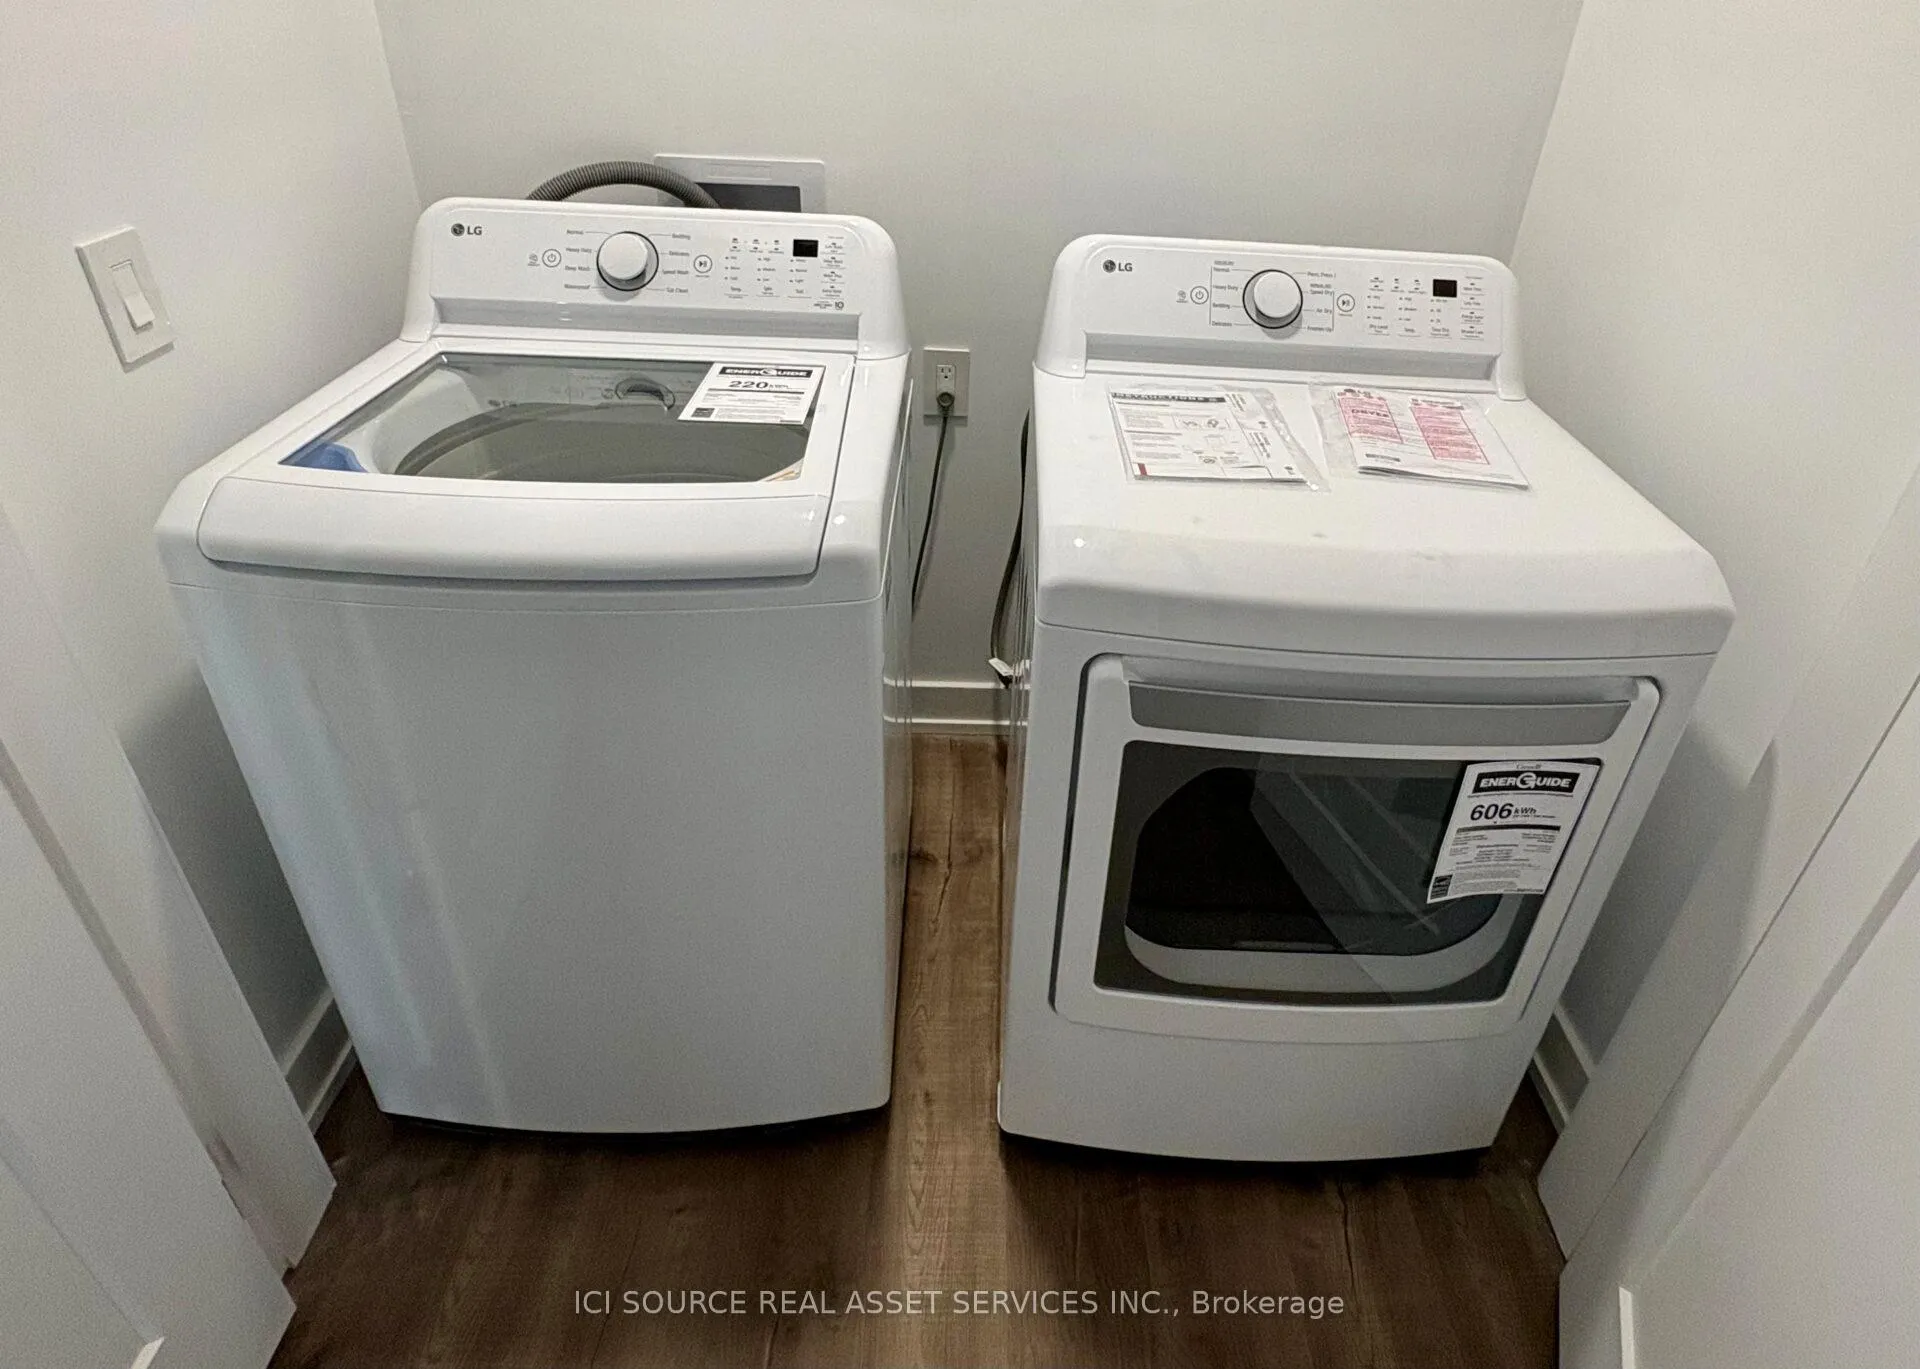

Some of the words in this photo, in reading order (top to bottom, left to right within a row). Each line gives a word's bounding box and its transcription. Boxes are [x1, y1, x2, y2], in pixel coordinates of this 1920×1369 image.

[725, 367, 808, 377] ENERGUIDE
[728, 380, 769, 389] 220
[1479, 771, 1573, 789] ENERGUIDE
[1470, 803, 1514, 821] 606
[1513, 806, 1537, 815] kWh
